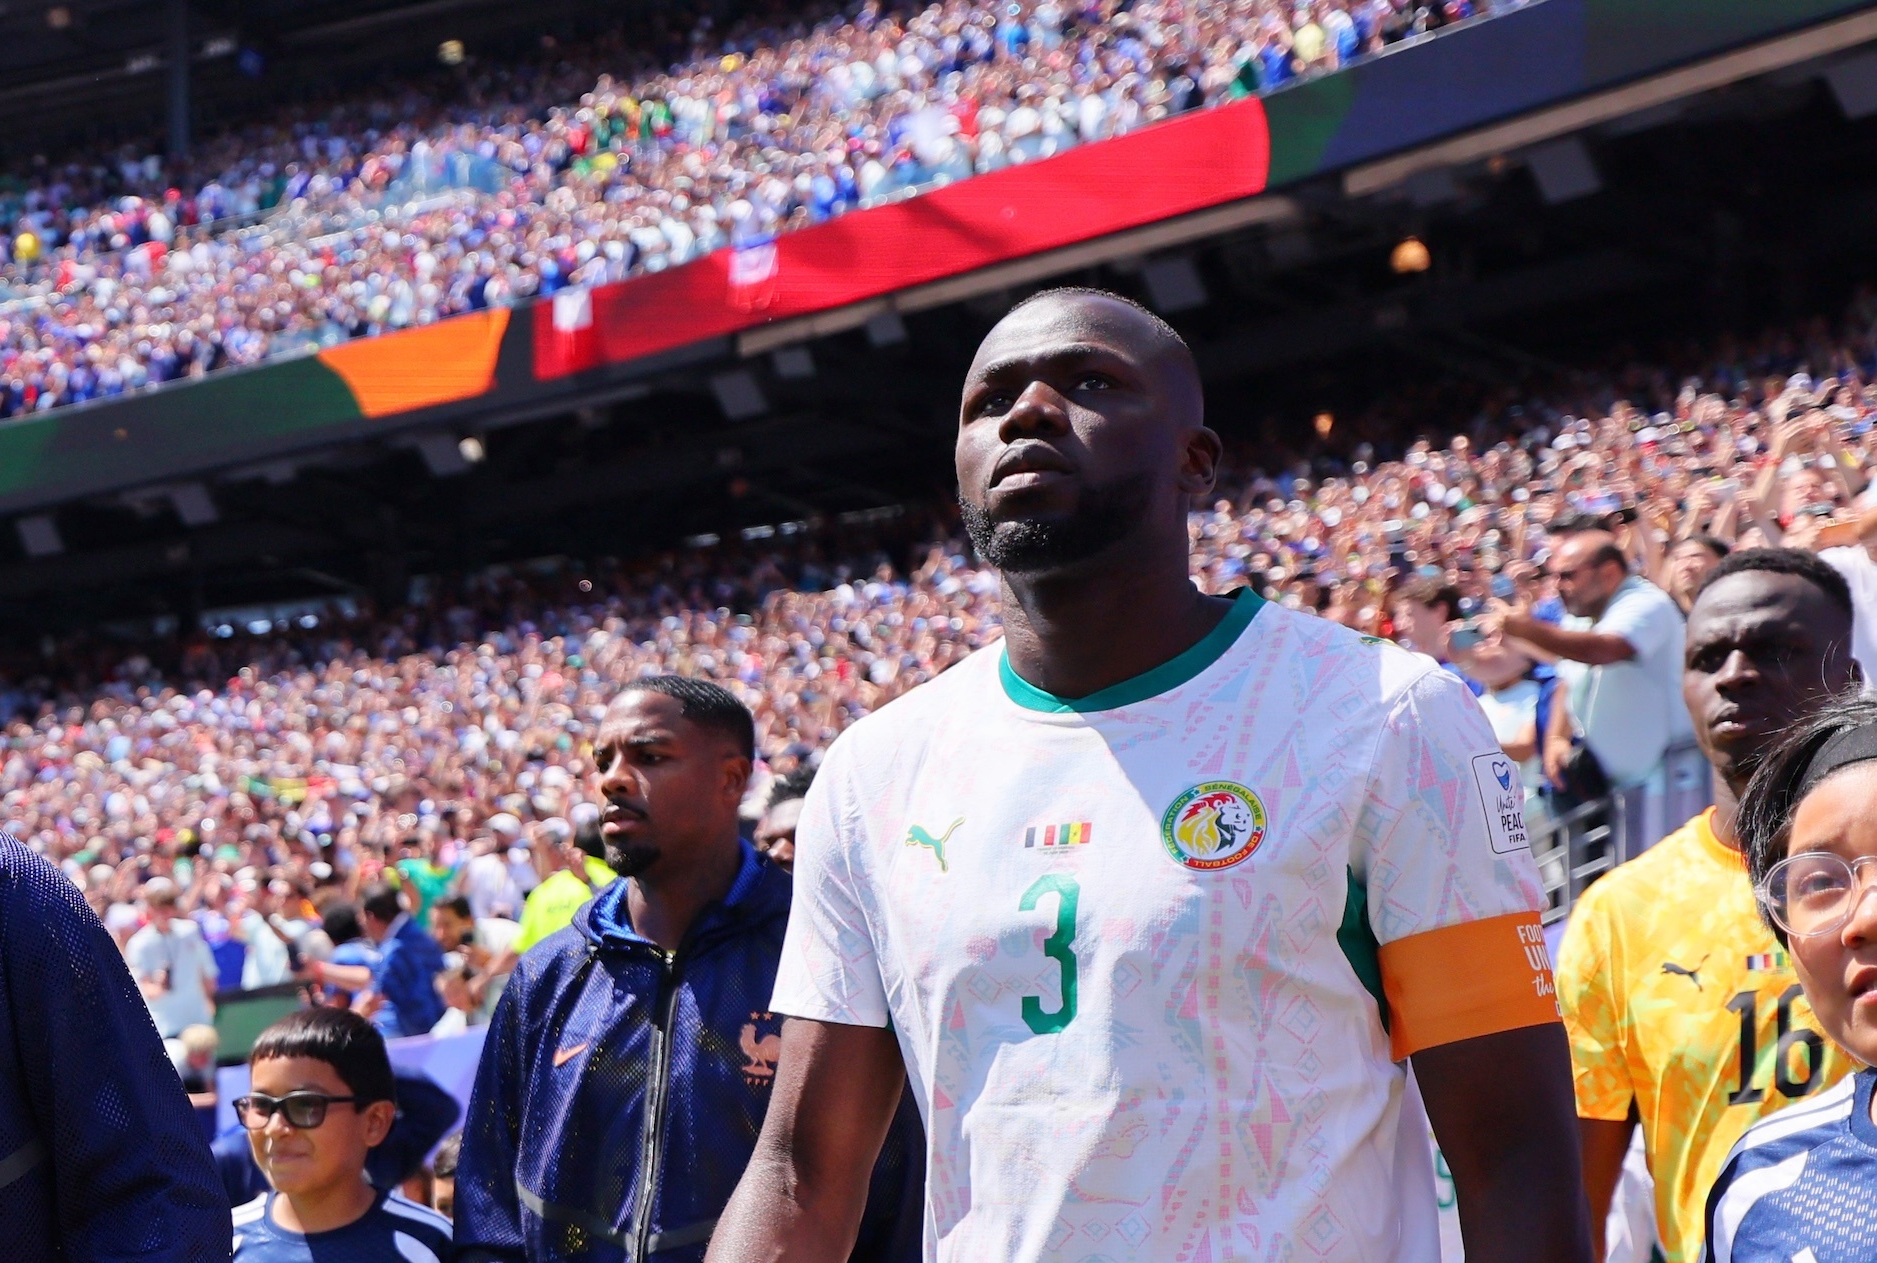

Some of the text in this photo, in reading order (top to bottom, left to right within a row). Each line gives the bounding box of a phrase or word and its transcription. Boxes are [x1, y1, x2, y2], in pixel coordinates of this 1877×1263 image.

[1193, 848, 1249, 868] FOOTBALL
[1509, 833, 1526, 844] FIFA
[1018, 873, 1081, 1035] 3
[1725, 982, 1825, 1107] 16
